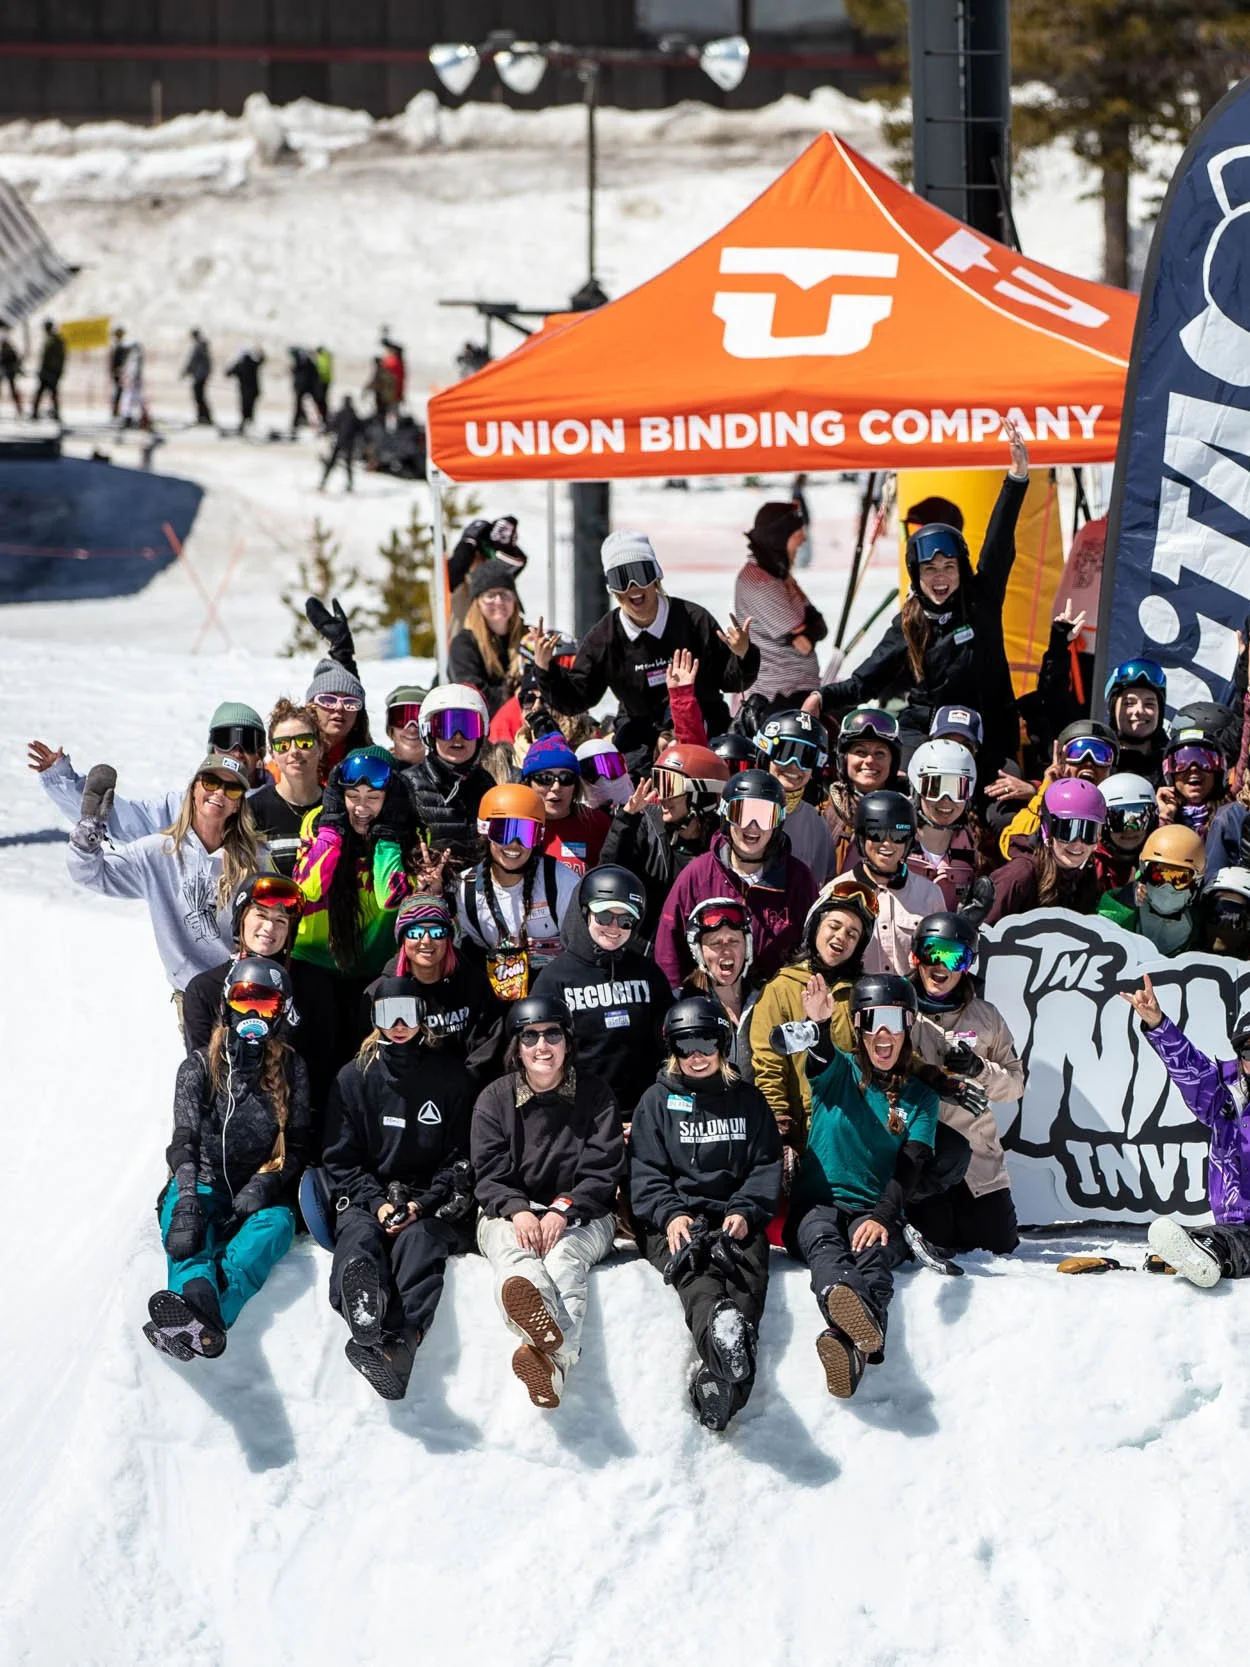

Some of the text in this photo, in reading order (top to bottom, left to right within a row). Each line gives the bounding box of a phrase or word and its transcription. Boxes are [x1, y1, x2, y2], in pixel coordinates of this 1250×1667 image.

[465, 405, 1104, 457] UNION BINDING COMPANY
[1015, 932, 1113, 994] THE
[563, 979, 650, 1012] SECURITY
[679, 1117, 746, 1136] SALOMON
